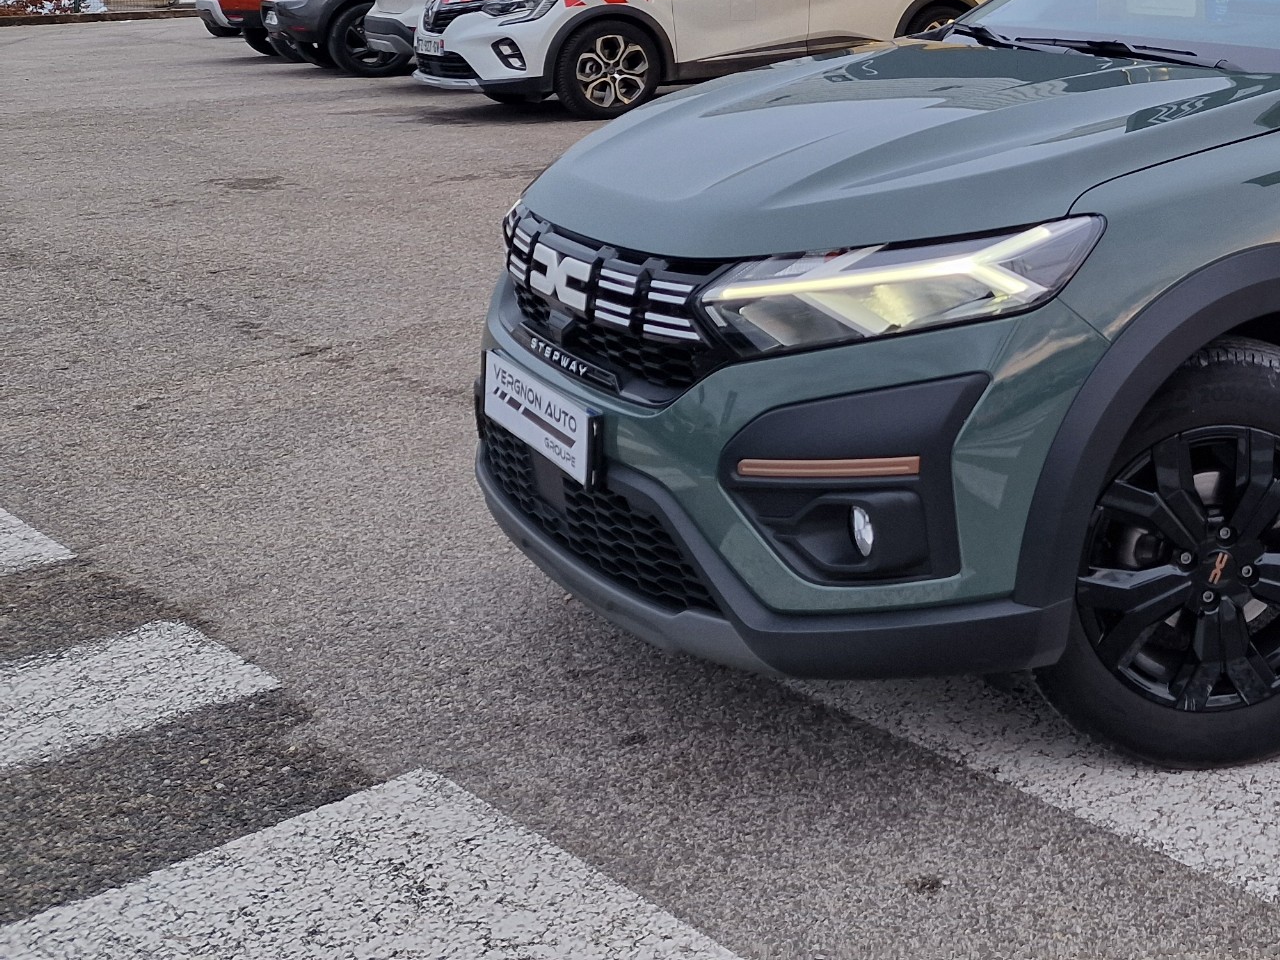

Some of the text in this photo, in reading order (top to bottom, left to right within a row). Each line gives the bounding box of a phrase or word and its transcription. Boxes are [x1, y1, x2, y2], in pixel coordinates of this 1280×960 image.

[530, 337, 589, 376] STEPWAY
[493, 363, 578, 433] VERGNON AUTO
[543, 437, 577, 469] GROUPE
